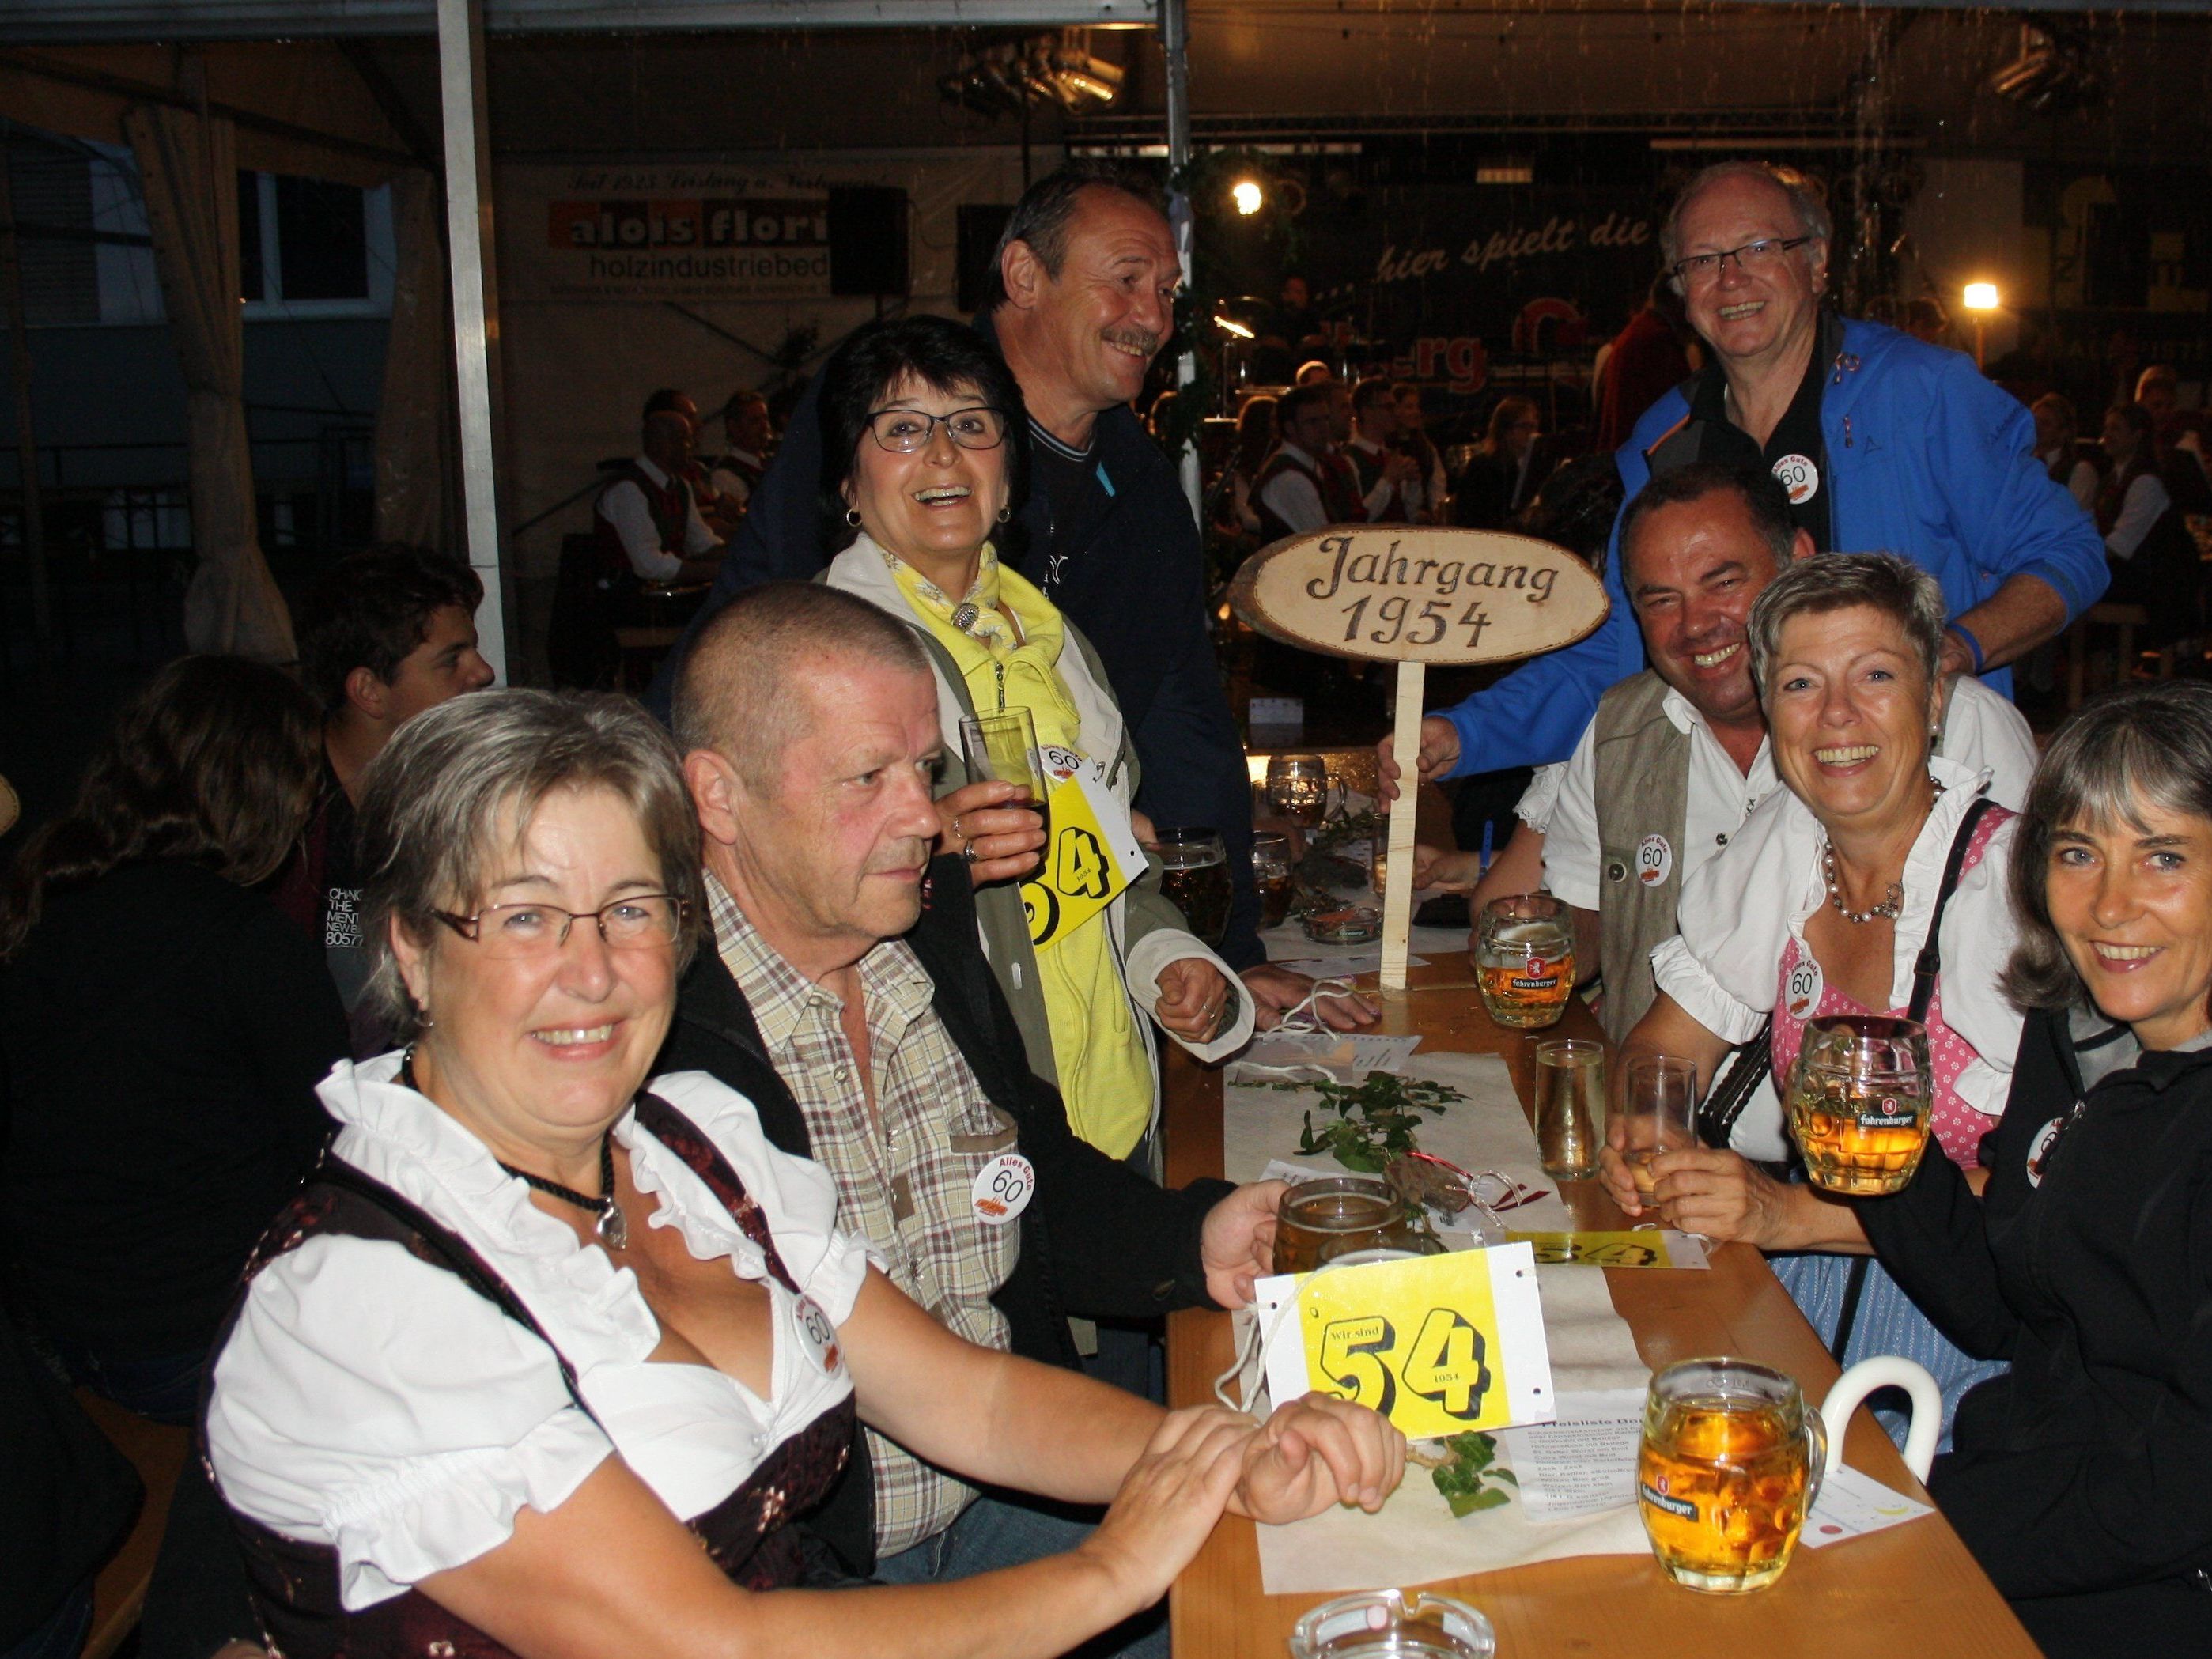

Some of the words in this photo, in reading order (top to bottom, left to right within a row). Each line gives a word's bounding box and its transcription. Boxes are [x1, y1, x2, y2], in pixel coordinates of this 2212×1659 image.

[571, 211, 695, 246] alois
[1376, 244, 1450, 283] hier
[1461, 214, 1576, 274] spielt
[1588, 211, 1655, 247] die
[1780, 465, 1806, 486] 60
[1306, 536, 1560, 603] Jahrgang
[1342, 595, 1492, 648] 1954
[1048, 750, 1080, 769] 60
[1643, 846, 1663, 867] 60
[328, 899, 354, 912] THE
[1792, 973, 1813, 995] 60
[992, 1170, 1024, 1203] 60
[999, 1157, 1023, 1169] Alles
[1023, 1166, 1034, 1191] Gute
[806, 1311, 830, 1345] 60
[1330, 1328, 1352, 1342] Wir
[1354, 1325, 1380, 1340] sind
[1320, 1307, 1492, 1421] 54
